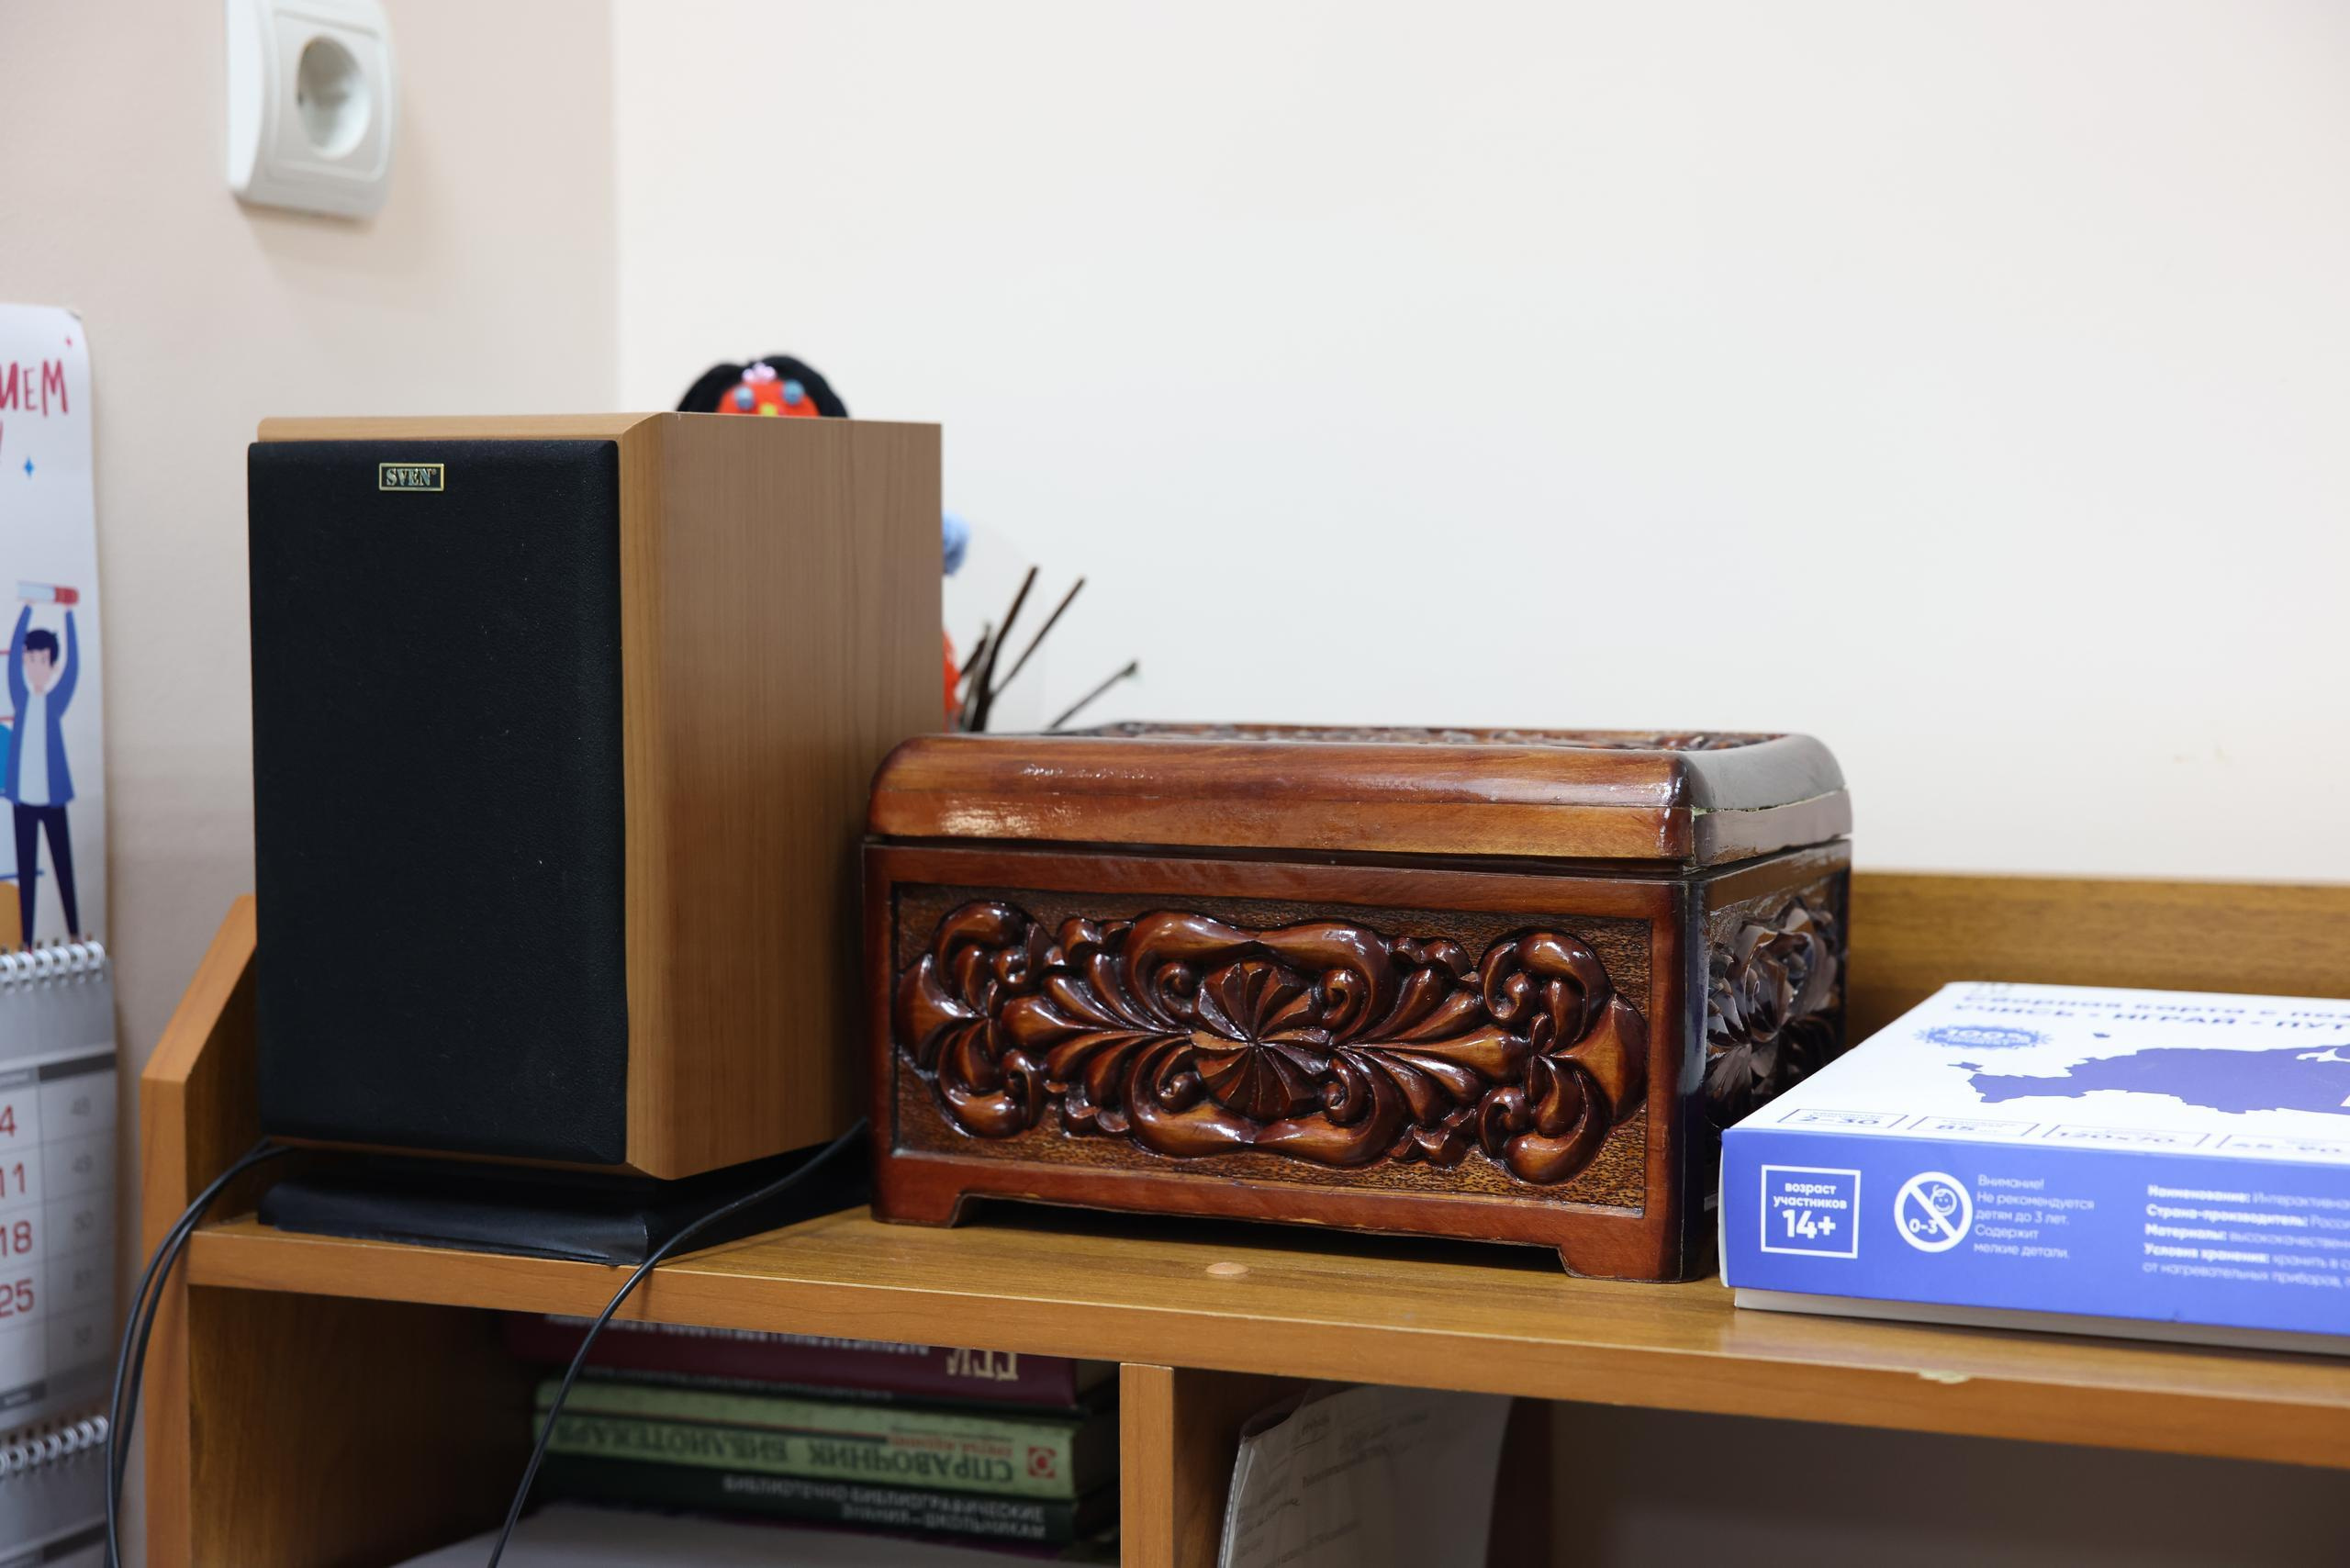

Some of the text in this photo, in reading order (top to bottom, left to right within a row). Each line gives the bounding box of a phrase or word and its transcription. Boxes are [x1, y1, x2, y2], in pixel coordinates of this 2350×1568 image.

[386, 467, 431, 487] SVEN
[0, 1104, 17, 1137] 4
[1785, 1182, 1837, 1196] возраст
[1977, 1174, 2045, 1191] Внимание!
[1773, 1195, 1848, 1210] участников
[1976, 1192, 2095, 1210] Не рекомендуется
[2147, 1184, 2251, 1204] Наименование:
[1782, 1209, 1837, 1239] 14+
[1975, 1210, 2070, 1226] детям до 3 лет.
[2145, 1203, 2309, 1227] Страна-производитель:
[1908, 1218, 1939, 1234] 0-3
[1975, 1224, 2039, 1239] Содержит
[2144, 1222, 2227, 1240] Материалы:
[0, 1220, 33, 1257] 18
[1974, 1243, 2071, 1259] мелкие детали.
[2143, 1242, 2199, 1259] Условия
[2199, 1248, 2270, 1264] хранения:
[0, 1279, 35, 1318] 25
[808, 1443, 1014, 1484] СПРАВОЧНИК
